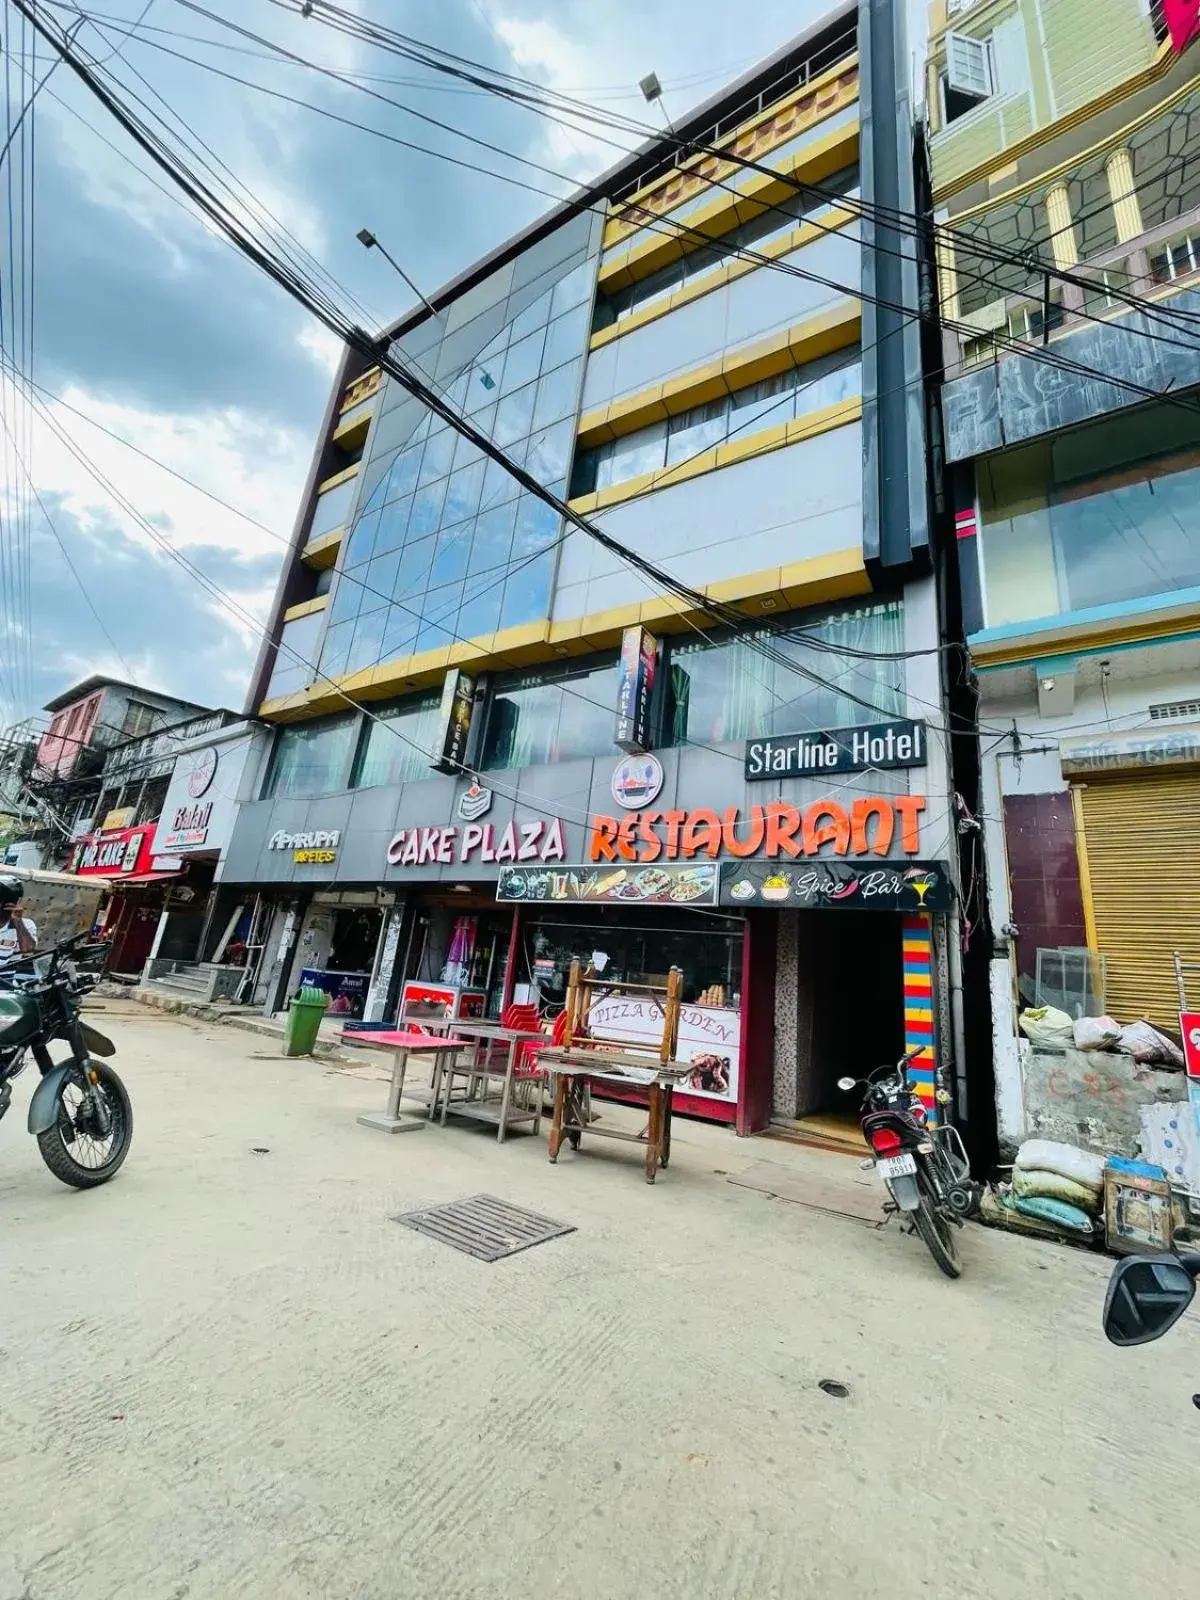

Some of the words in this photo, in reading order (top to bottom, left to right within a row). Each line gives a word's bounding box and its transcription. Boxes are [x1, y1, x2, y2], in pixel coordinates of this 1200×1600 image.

[617, 662, 632, 739] STARLINE
[748, 738, 838, 774] Starline
[852, 725, 921, 764] Hotel
[173, 802, 214, 832] Balaji
[588, 795, 926, 863] RESTAURANT
[97, 841, 126, 866] CAKE
[267, 829, 341, 850] APARUPA
[387, 826, 457, 865] CAKE
[461, 817, 567, 864] PLAZA
[795, 871, 845, 900] Spice
[860, 871, 903, 899] Bar
[595, 1004, 643, 1023] PIZZA
[649, 1004, 734, 1041] GRDEN
